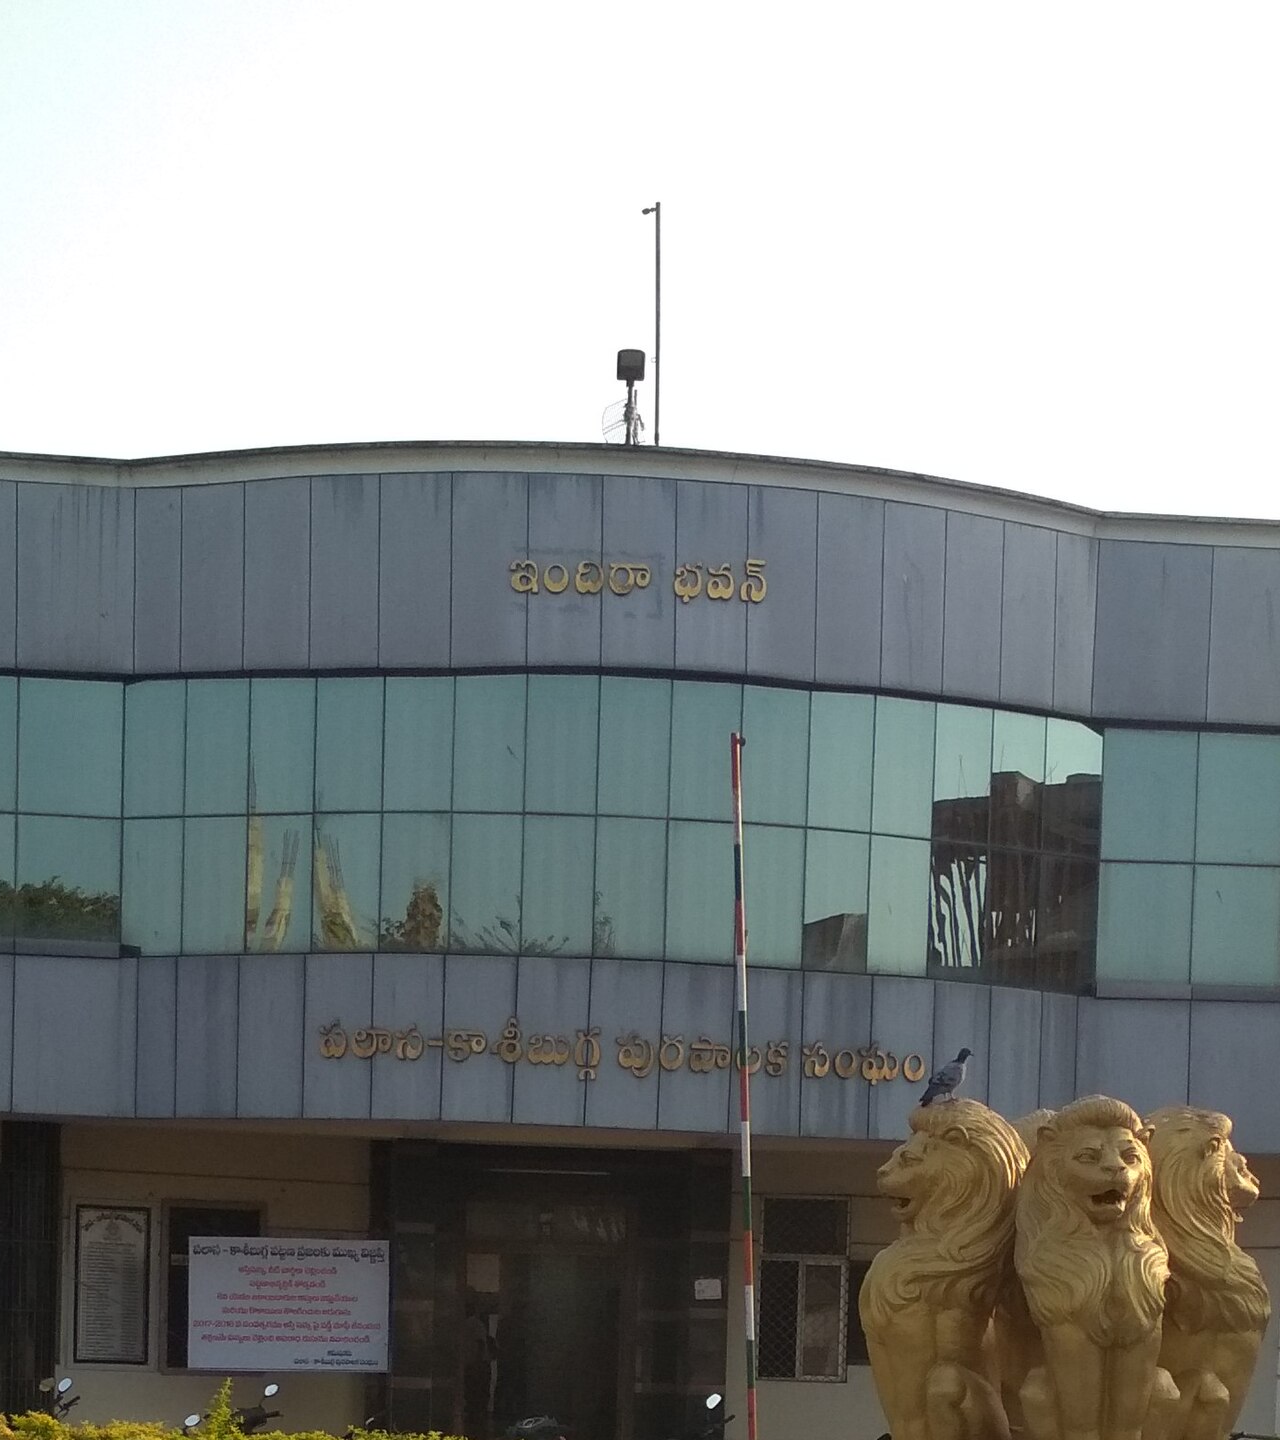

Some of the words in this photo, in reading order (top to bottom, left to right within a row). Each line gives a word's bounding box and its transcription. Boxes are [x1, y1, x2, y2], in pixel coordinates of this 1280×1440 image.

[509, 559, 652, 596] ఇందిరా
[673, 557, 768, 604] భవన్
[616, 1031, 789, 1078] పురపాలక
[803, 1040, 926, 1086] సంఘం
